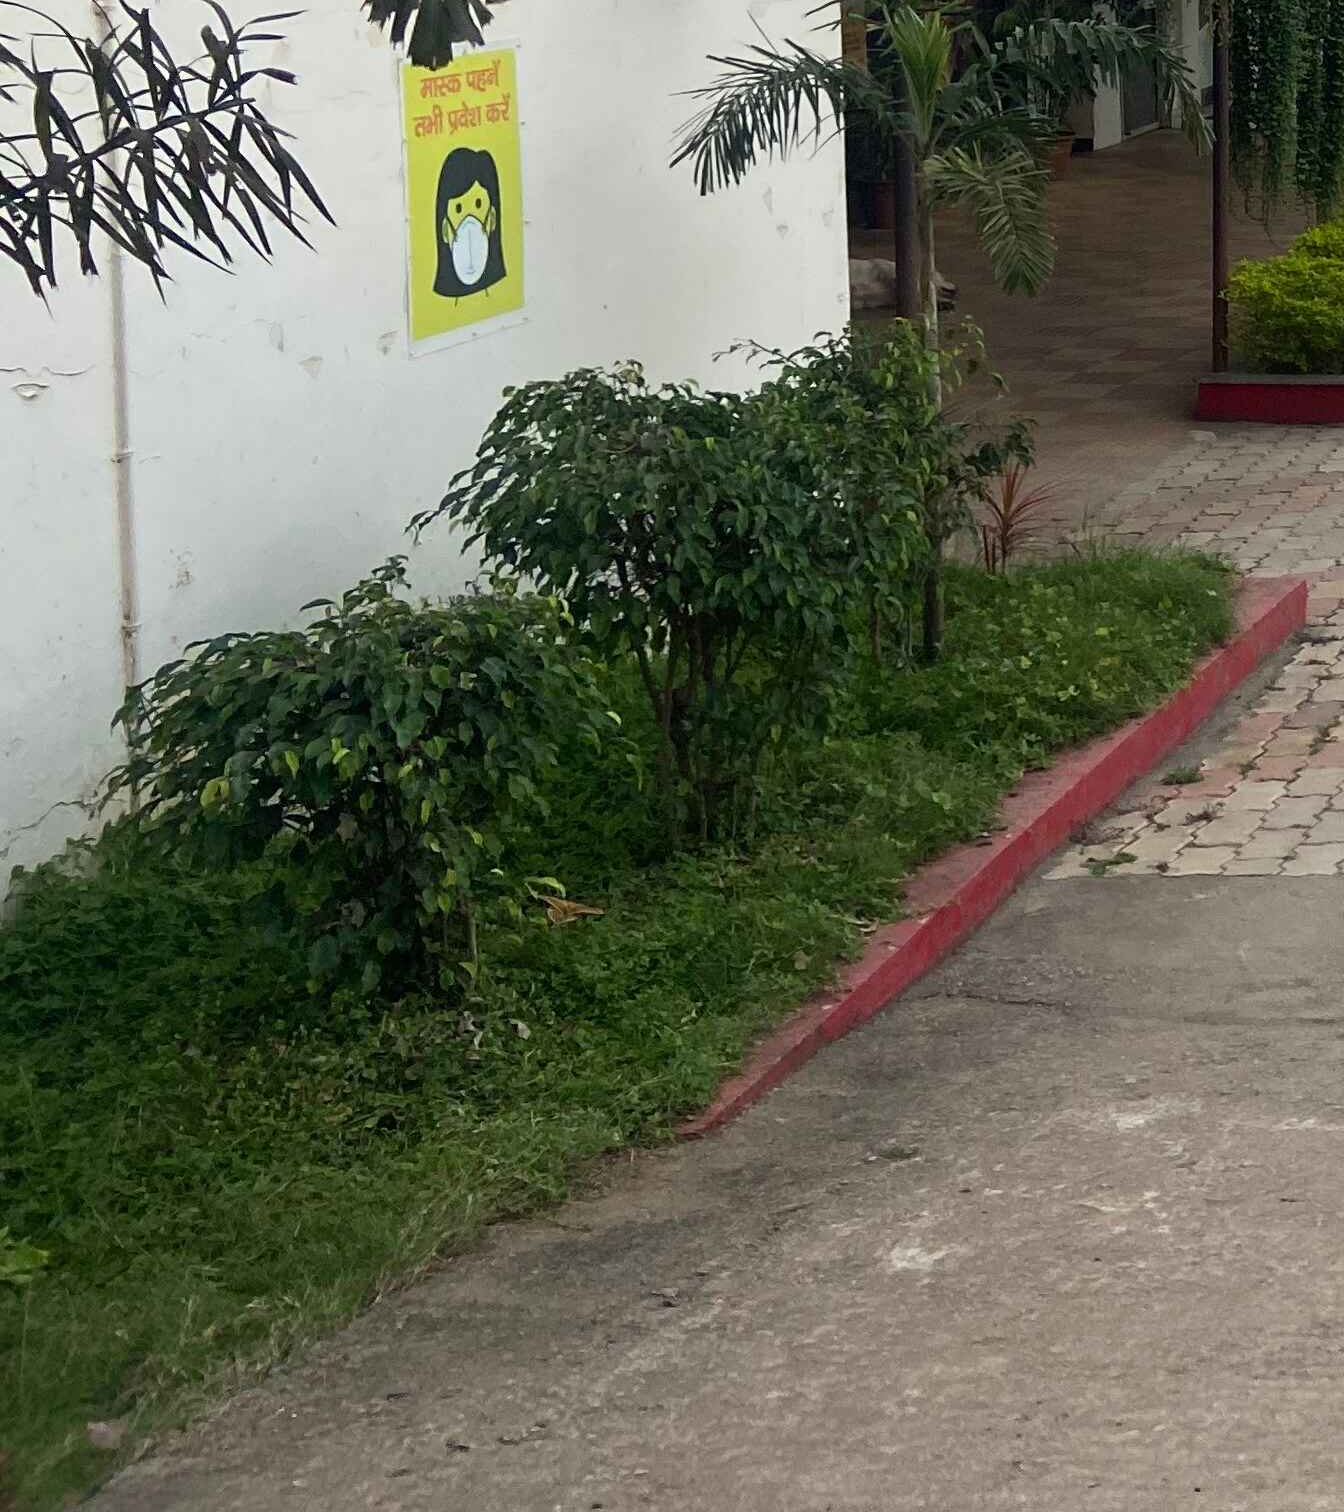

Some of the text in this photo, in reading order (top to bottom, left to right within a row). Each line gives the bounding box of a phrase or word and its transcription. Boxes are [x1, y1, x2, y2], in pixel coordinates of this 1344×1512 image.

[420, 59, 501, 99] मास्क पहनें
[412, 92, 511, 138] तभी प्रवेश करें
